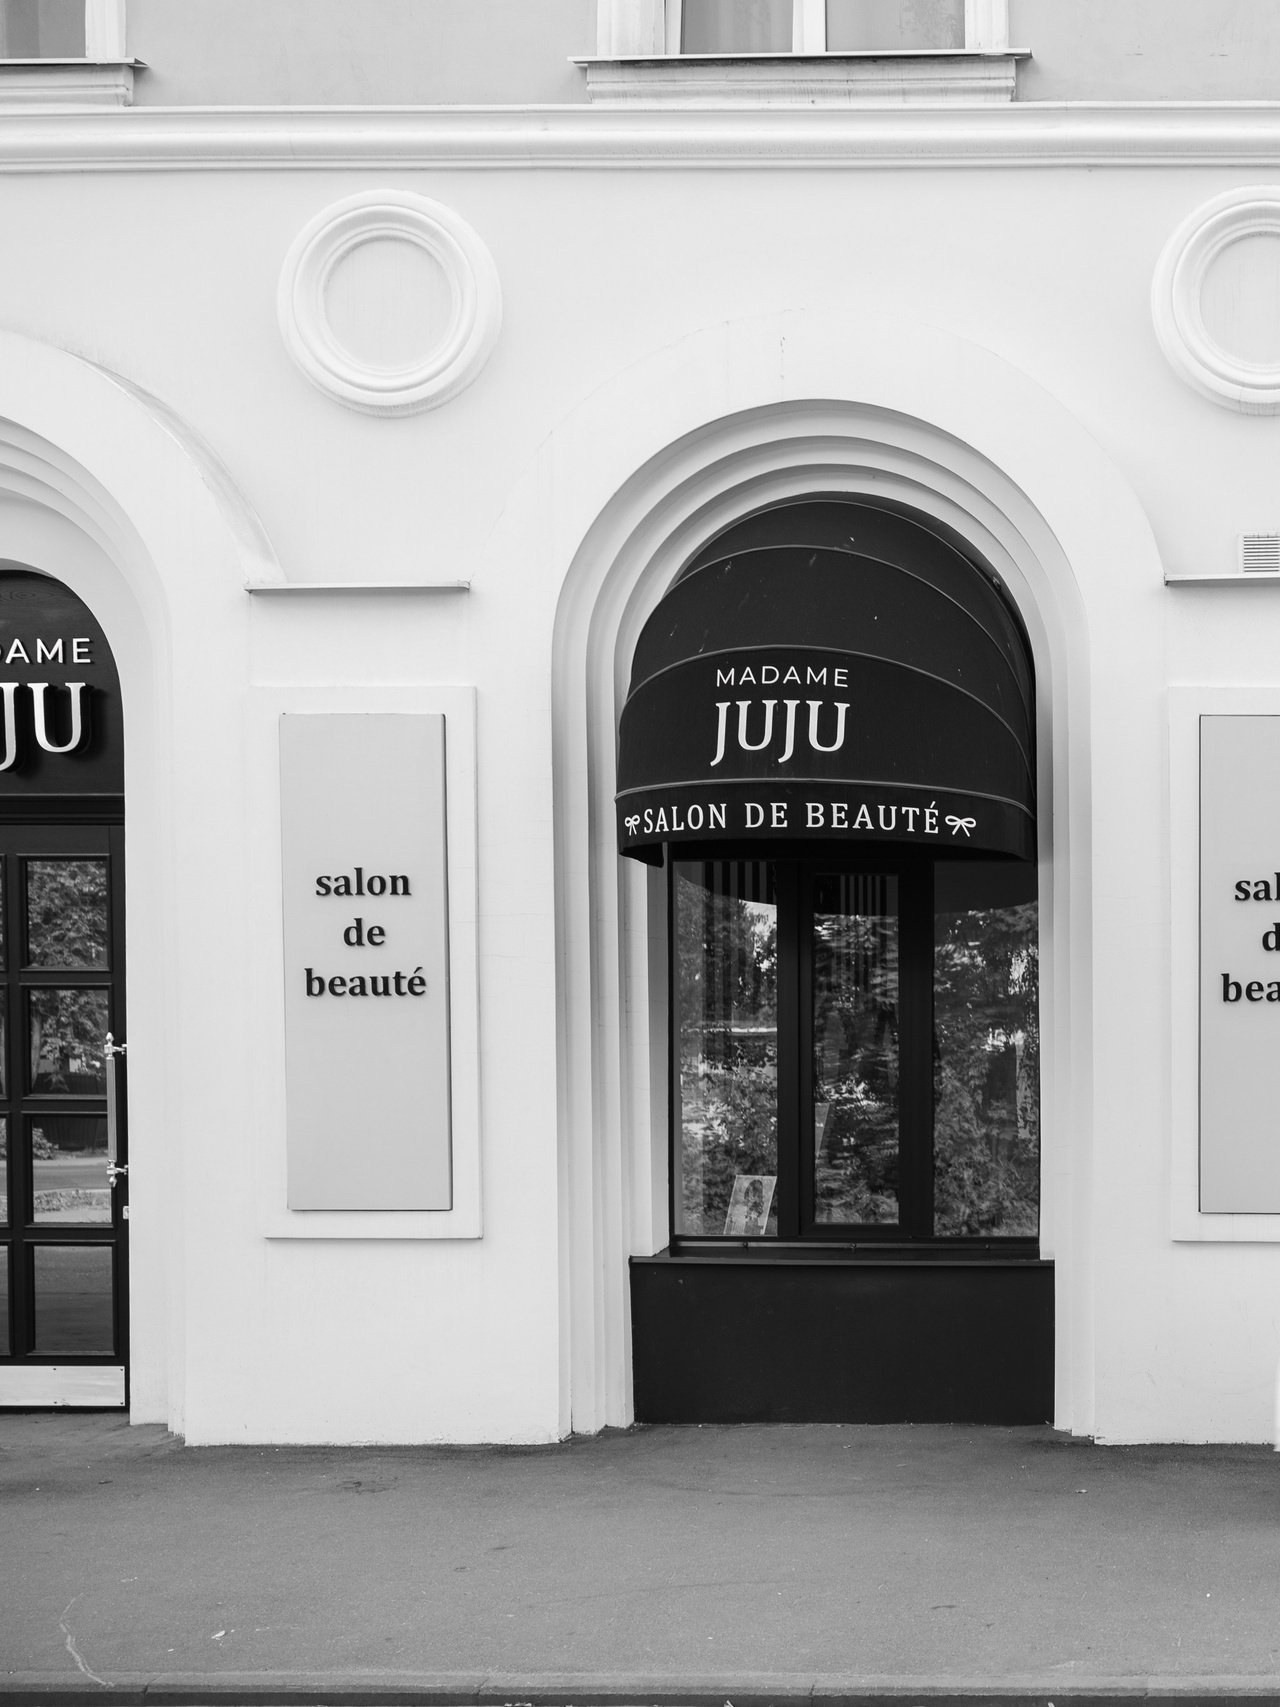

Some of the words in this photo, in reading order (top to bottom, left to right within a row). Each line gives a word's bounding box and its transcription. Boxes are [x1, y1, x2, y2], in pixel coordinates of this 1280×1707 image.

[716, 665, 849, 688] MADAME
[709, 699, 851, 767] JUJU
[643, 803, 727, 834] SALON
[744, 802, 788, 828] DE
[805, 800, 939, 834] BEAUTÉ
[315, 867, 412, 897] salon
[343, 917, 386, 947] de
[304, 966, 427, 997] beauté
